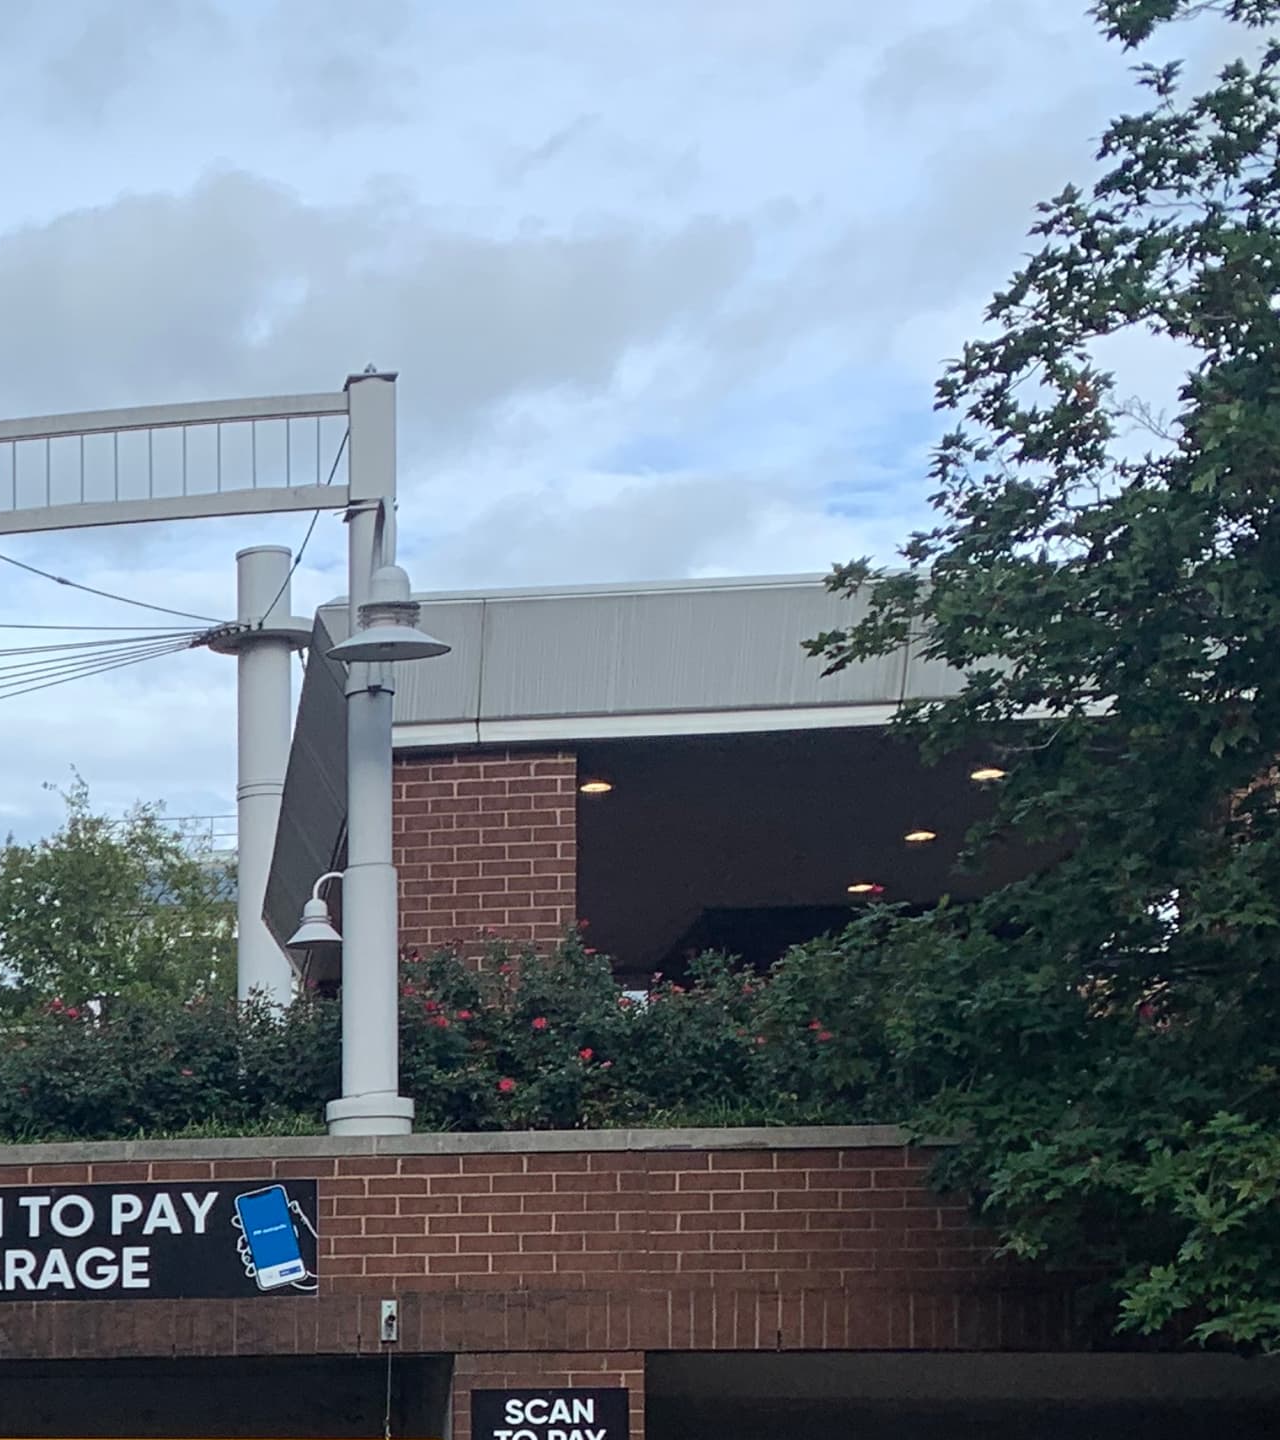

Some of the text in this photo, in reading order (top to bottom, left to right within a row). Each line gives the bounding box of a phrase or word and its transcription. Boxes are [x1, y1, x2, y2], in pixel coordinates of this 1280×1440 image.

[19, 1195, 95, 1238] TO
[112, 1191, 219, 1236] PAY
[504, 1398, 594, 1425] SCAN
